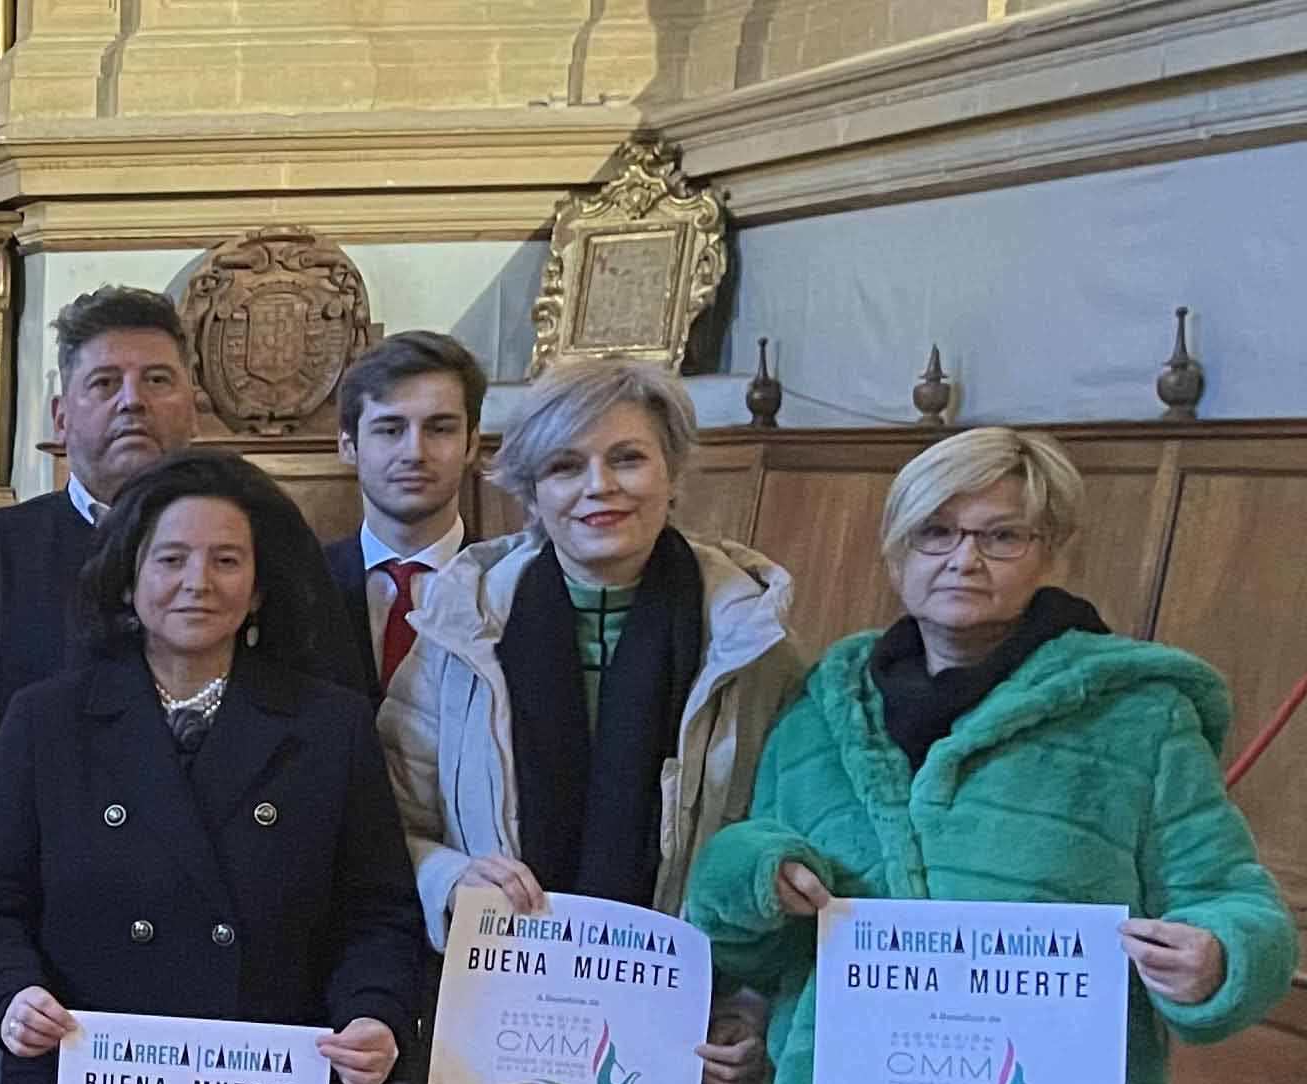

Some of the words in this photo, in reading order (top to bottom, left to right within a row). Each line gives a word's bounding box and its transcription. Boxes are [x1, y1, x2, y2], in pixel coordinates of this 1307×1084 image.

[496, 916, 572, 943] CARRERA
[878, 923, 965, 954] CARRERA
[468, 947, 547, 976] BUENA
[574, 955, 680, 989] MUERTE
[847, 963, 939, 992] BUENA
[970, 968, 1089, 998] MUERTE
[114, 1037, 190, 1067] CARRERA
[496, 1030, 589, 1057] CMM
[887, 1051, 992, 1080] CMM
